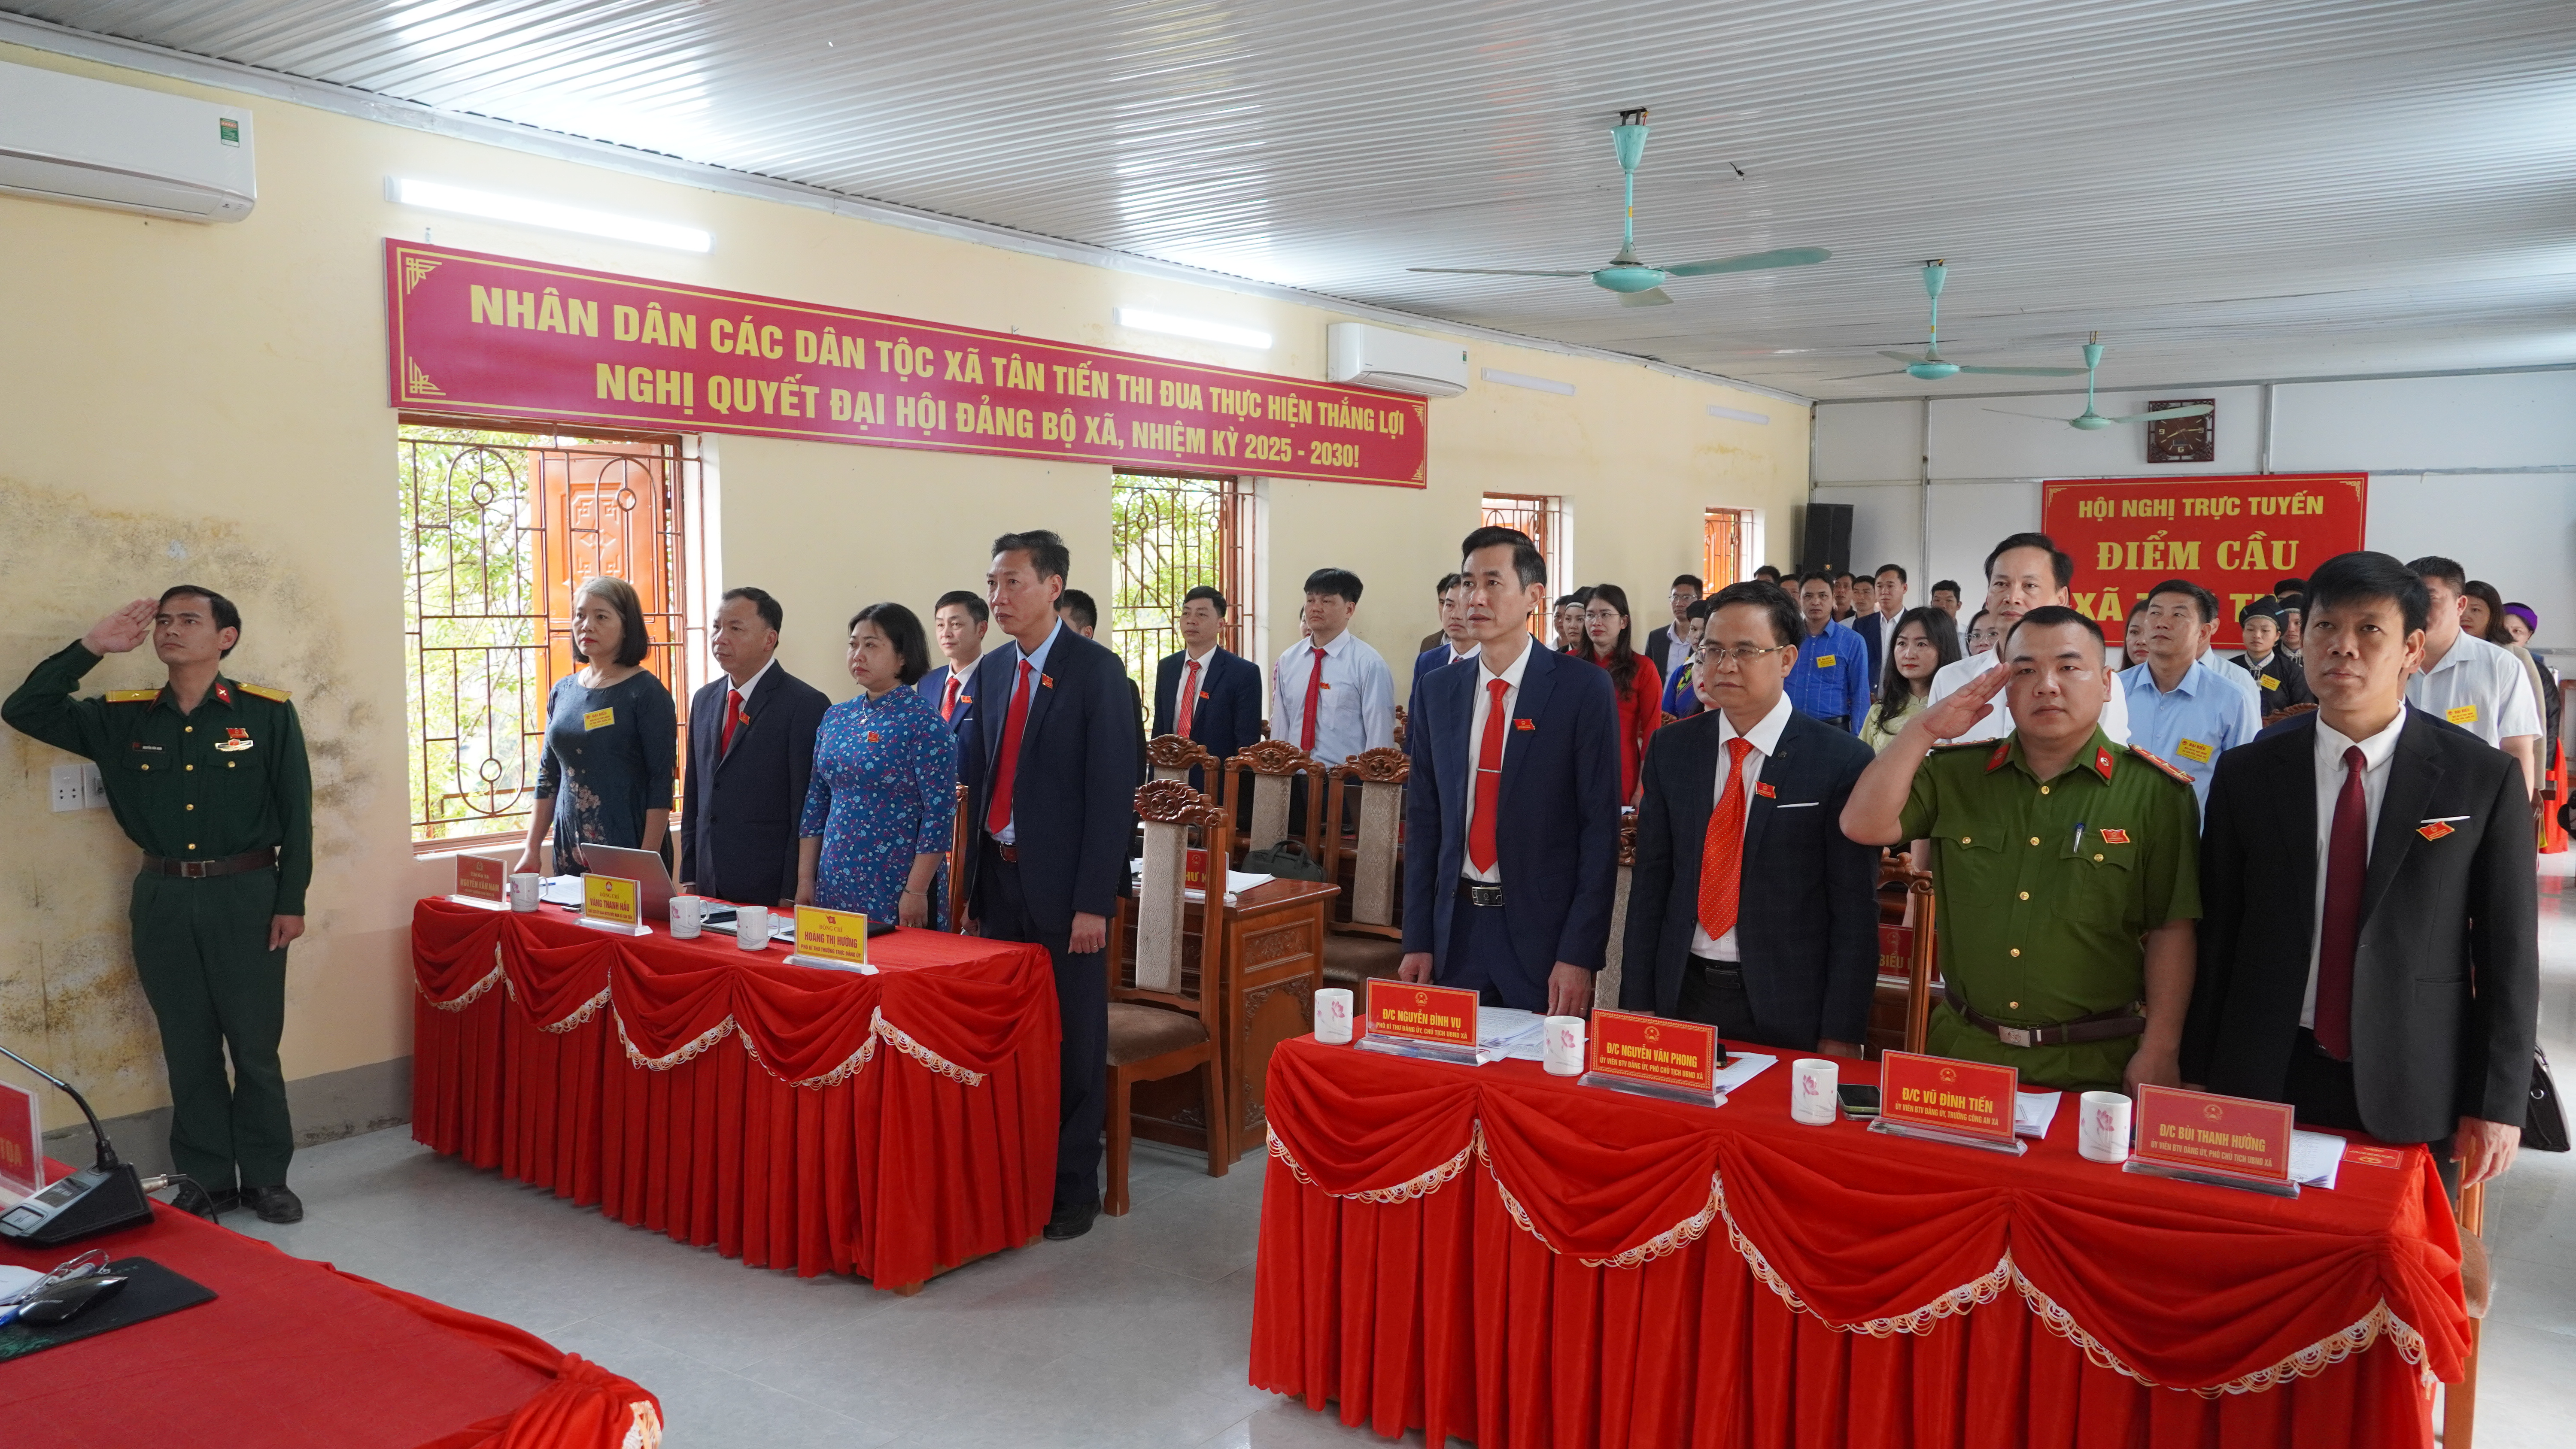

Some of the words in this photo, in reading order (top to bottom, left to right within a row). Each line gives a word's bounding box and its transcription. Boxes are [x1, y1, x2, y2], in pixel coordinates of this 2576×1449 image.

[471, 284, 598, 338] NHÂN
[614, 301, 697, 349] DÂN
[711, 315, 784, 360] CÁC
[796, 326, 866, 370] DÂN
[875, 336, 934, 382] TỘC
[945, 348, 984, 384] XÃ
[992, 353, 1045, 391] TÂN
[1053, 360, 1109, 399] TIẾN
[1116, 374, 1152, 405] THI
[1160, 381, 1203, 411] ĐUA
[1209, 387, 1262, 418] THỰC
[1268, 393, 1312, 428] HIỆN
[1318, 397, 1375, 432] THẮNG
[1379, 411, 1404, 440] LỢI
[597, 363, 694, 415] NGHỊ
[708, 373, 819, 419] QUYẾT
[830, 390, 885, 431] ĐẠI
[896, 391, 947, 436] HỘI
[956, 395, 1033, 439] ĐẢNG
[1042, 407, 1076, 449] BỘ
[1084, 412, 1124, 450] XÃ,
[1132, 420, 1206, 458] NHIỆM
[1213, 426, 1239, 457] KỲ
[1245, 433, 1292, 461] 2025
[1310, 440, 1360, 468] 2030!
[2079, 497, 2115, 522] HỘI
[2121, 498, 2175, 521] NGHỊ
[2183, 495, 2242, 521] TRỰC
[2248, 490, 2324, 515] TUYẾN
[2096, 529, 2202, 571] ĐIỂM
[2216, 530, 2300, 571] CẦU
[2072, 586, 2124, 621] XÃ
[1186, 871, 1199, 882] HƯ
[603, 900, 619, 910] THANH
[805, 931, 825, 943] HOÀNG
[826, 934, 835, 947] THỊ
[1382, 1008, 1396, 1021] Đ/C
[1397, 1009, 1428, 1025] NGUYỄN
[1430, 1012, 1449, 1027] ĐÌNH
[1451, 1017, 1461, 1031] VỤ
[1424, 1027, 1434, 1035] CHỦ
[1600, 1055, 1606, 1064] ỦY
[1649, 1064, 1659, 1072] PHÓ
[1660, 1065, 1670, 1074] CHỦ
[1671, 1068, 1682, 1077] TỊCH
[1682, 1070, 1696, 1079] UBND
[1696, 1072, 1704, 1080] XÃ
[1607, 1042, 1620, 1055] Đ/C
[1621, 1043, 1652, 1061] NGUYỄN
[1653, 1048, 1669, 1064] VĂN
[1671, 1052, 1698, 1068] PHONG
[1895, 1100, 1902, 1110] ỦY
[1903, 1103, 1914, 1113] VIÊN
[1914, 1106, 1924, 1114] BTV
[1968, 1113, 1982, 1123] CÔNG
[1991, 1117, 1999, 1126] XÃ
[1902, 1087, 1920, 1102] Đ/C
[1923, 1089, 1937, 1104] VŨ
[1940, 1091, 1966, 1109] ĐÌNH
[1968, 1095, 1993, 1114] TIẾN
[2160, 1123, 2176, 1138] Đ/C
[2178, 1125, 2195, 1141] BÙI
[2197, 1129, 2230, 1147] THANH
[2159, 1141, 2172, 1151] VIÊN
[2172, 1144, 2183, 1153] BTV
[2209, 1149, 2220, 1159] PHÓ
[2234, 1154, 2247, 1163] TỊCH
[2248, 1156, 2263, 1166] UBND
[2264, 1158, 2273, 1167] XÃ
